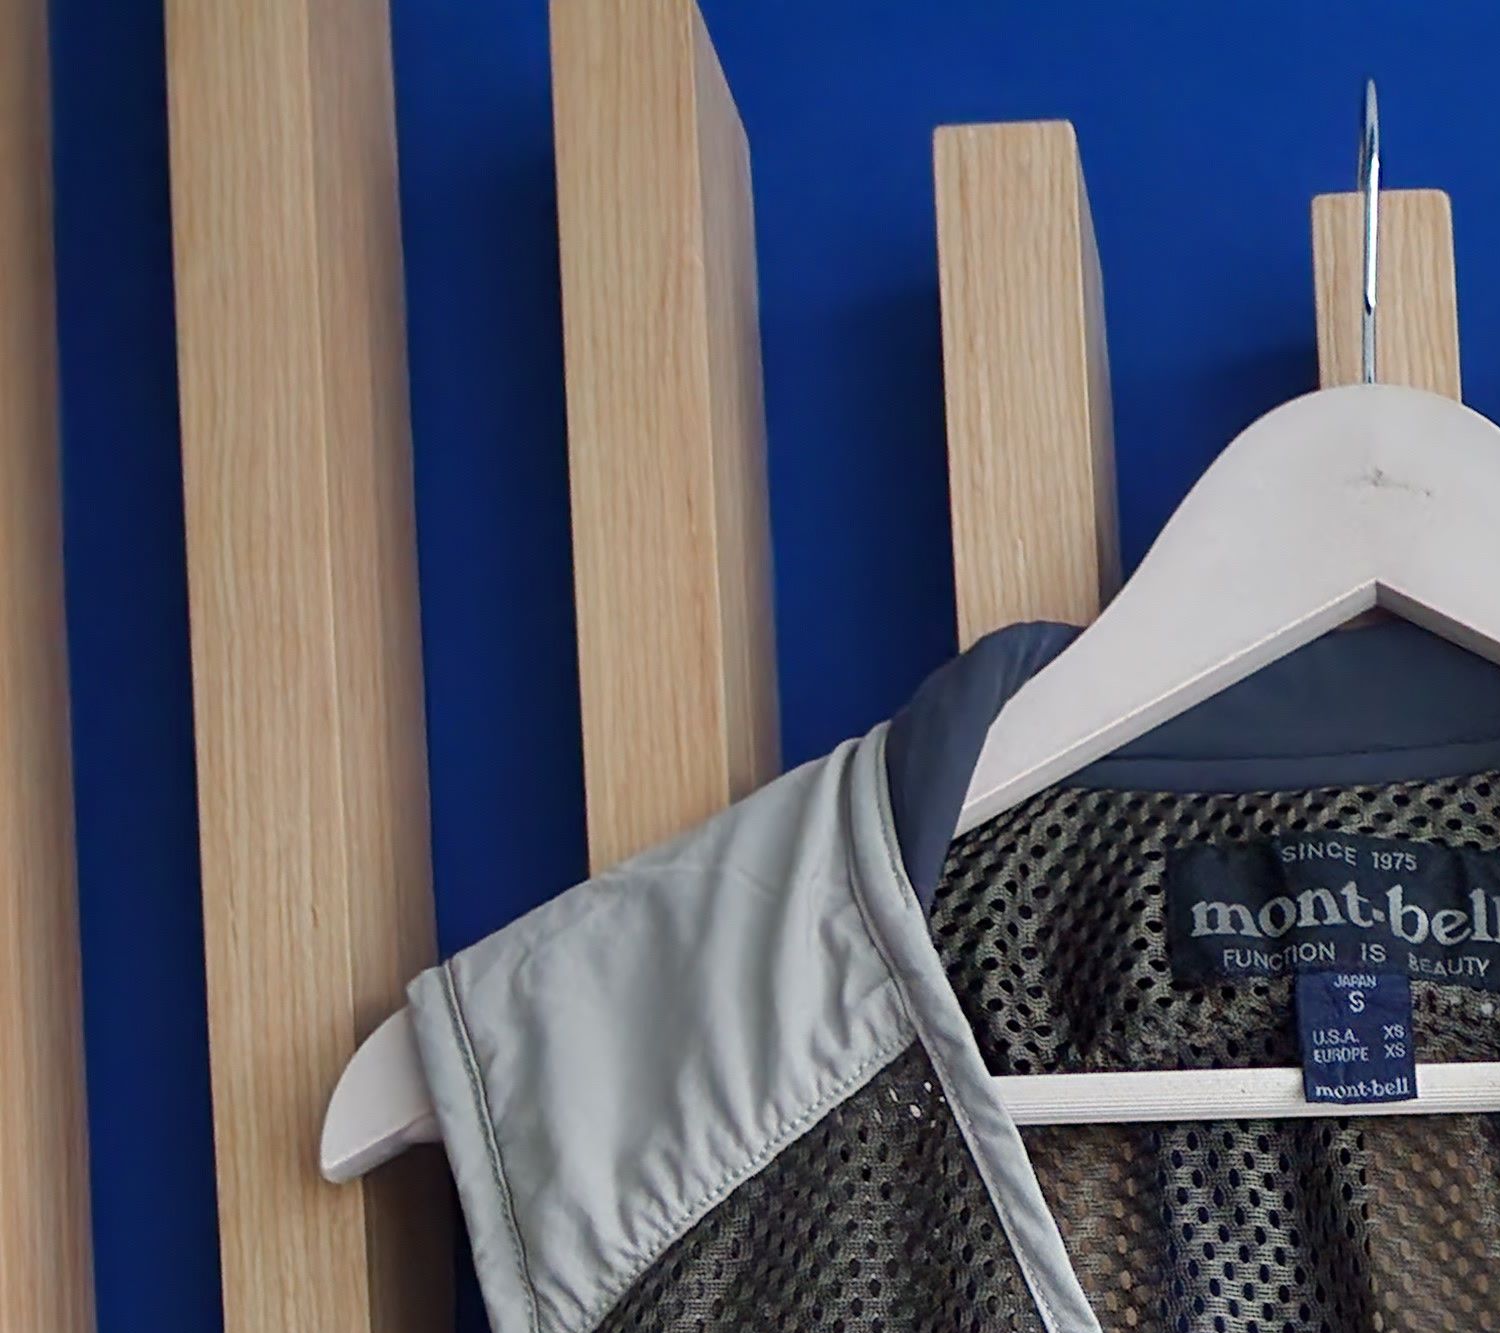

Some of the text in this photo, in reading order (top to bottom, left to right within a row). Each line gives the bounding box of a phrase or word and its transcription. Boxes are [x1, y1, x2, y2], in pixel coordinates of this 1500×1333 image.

[1281, 841, 1418, 872] SINCE 1975
[1223, 942, 1490, 977] FUNCTION IS BEAUTY
[1333, 974, 1377, 989] JAPAN
[1348, 990, 1366, 1013] S
[1312, 1024, 1405, 1046] U.S.A. XS
[1313, 1042, 1406, 1064] EUROPE XS
